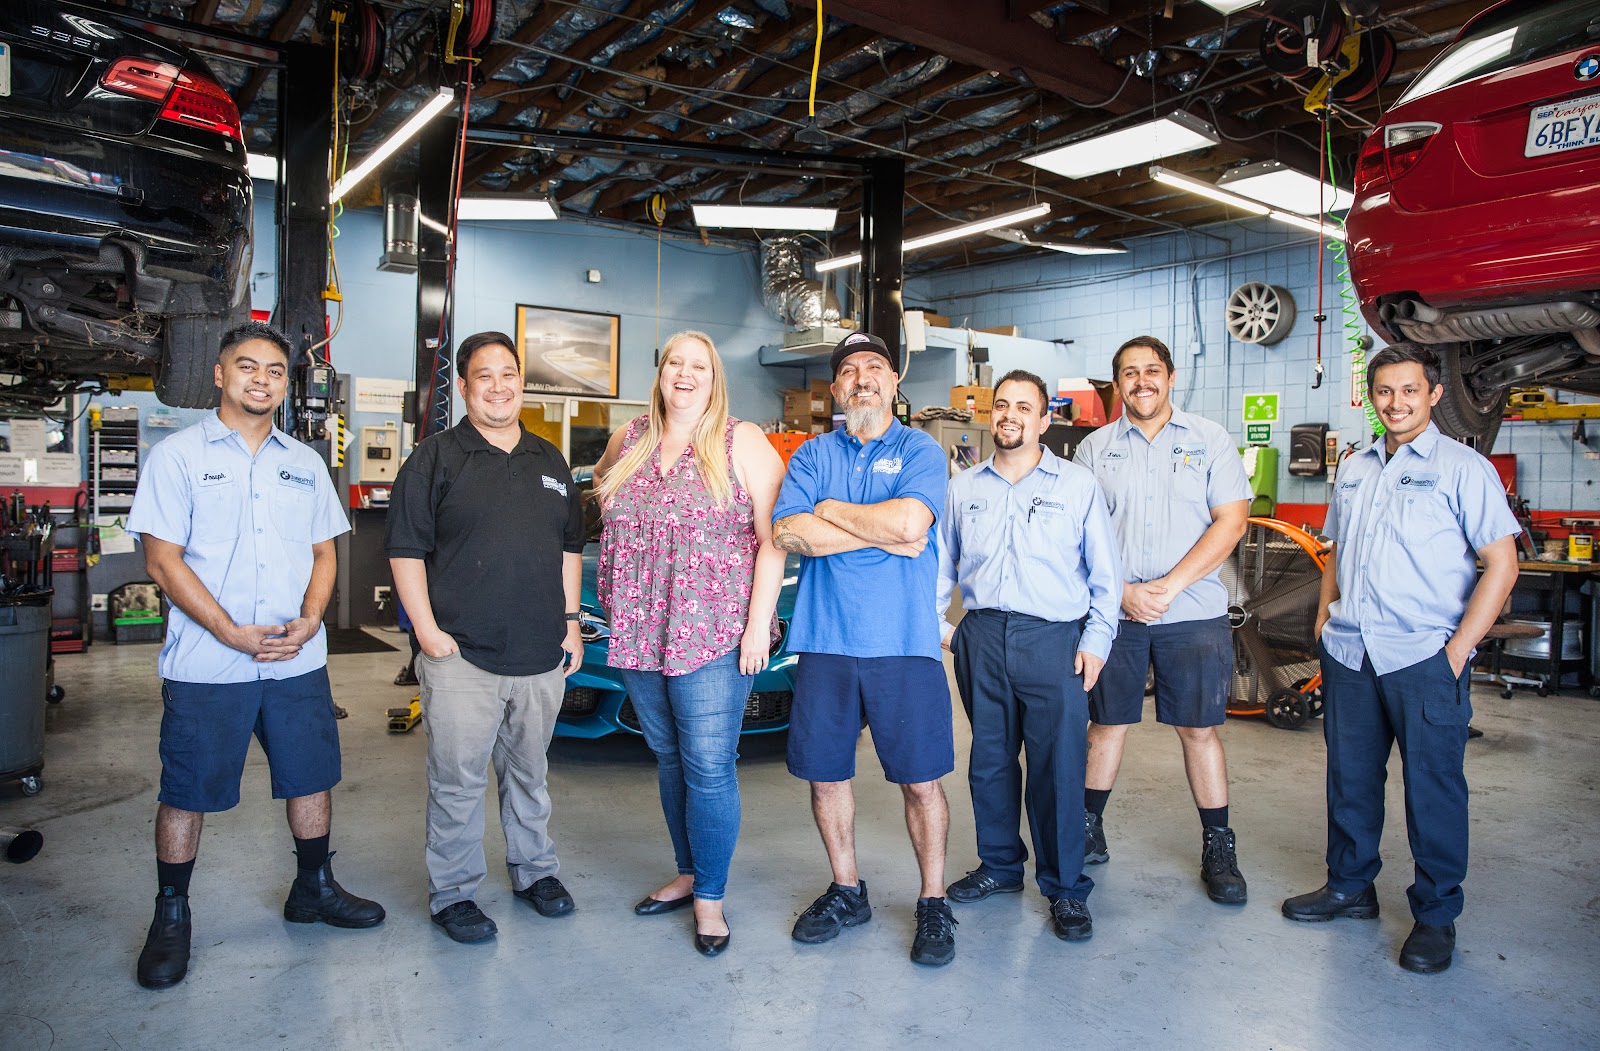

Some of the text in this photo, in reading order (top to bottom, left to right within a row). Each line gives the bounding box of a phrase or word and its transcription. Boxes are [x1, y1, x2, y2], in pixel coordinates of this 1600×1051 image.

[1537, 110, 1554, 119] SEP
[1556, 139, 1585, 150] THINK
[526, 382, 583, 393] BMW Performance
[203, 472, 226, 481] Joseph
